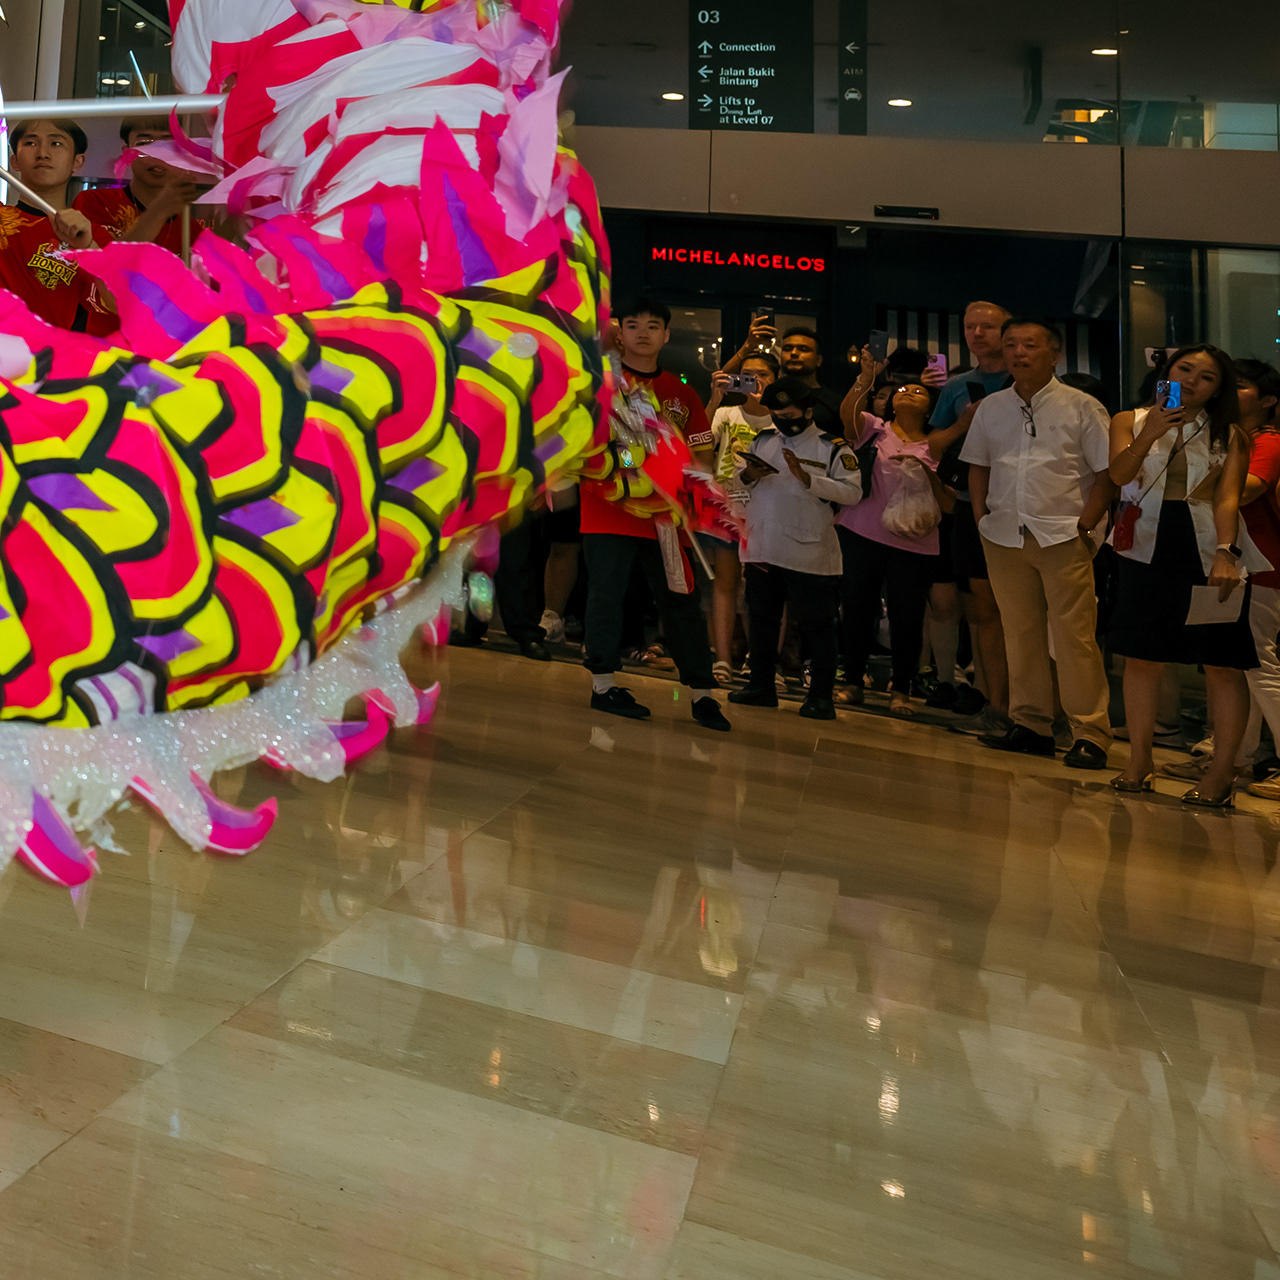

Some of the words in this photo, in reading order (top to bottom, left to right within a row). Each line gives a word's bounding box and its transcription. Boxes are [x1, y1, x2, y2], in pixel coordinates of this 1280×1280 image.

[698, 9, 721, 24] 03
[719, 42, 776, 52] Connection
[719, 67, 746, 77] Jalan
[748, 67, 776, 77] Bukit
[843, 68, 864, 76] ATM
[719, 77, 760, 88] Bintang
[719, 96, 742, 106] Lifts
[744, 97, 756, 106] to
[719, 106, 744, 117] Dining
[747, 106, 763, 116] Loft
[719, 116, 730, 125] at
[732, 115, 759, 125] Level
[760, 115, 775, 125] 07
[651, 247, 825, 272] MICHELANGELO'S
